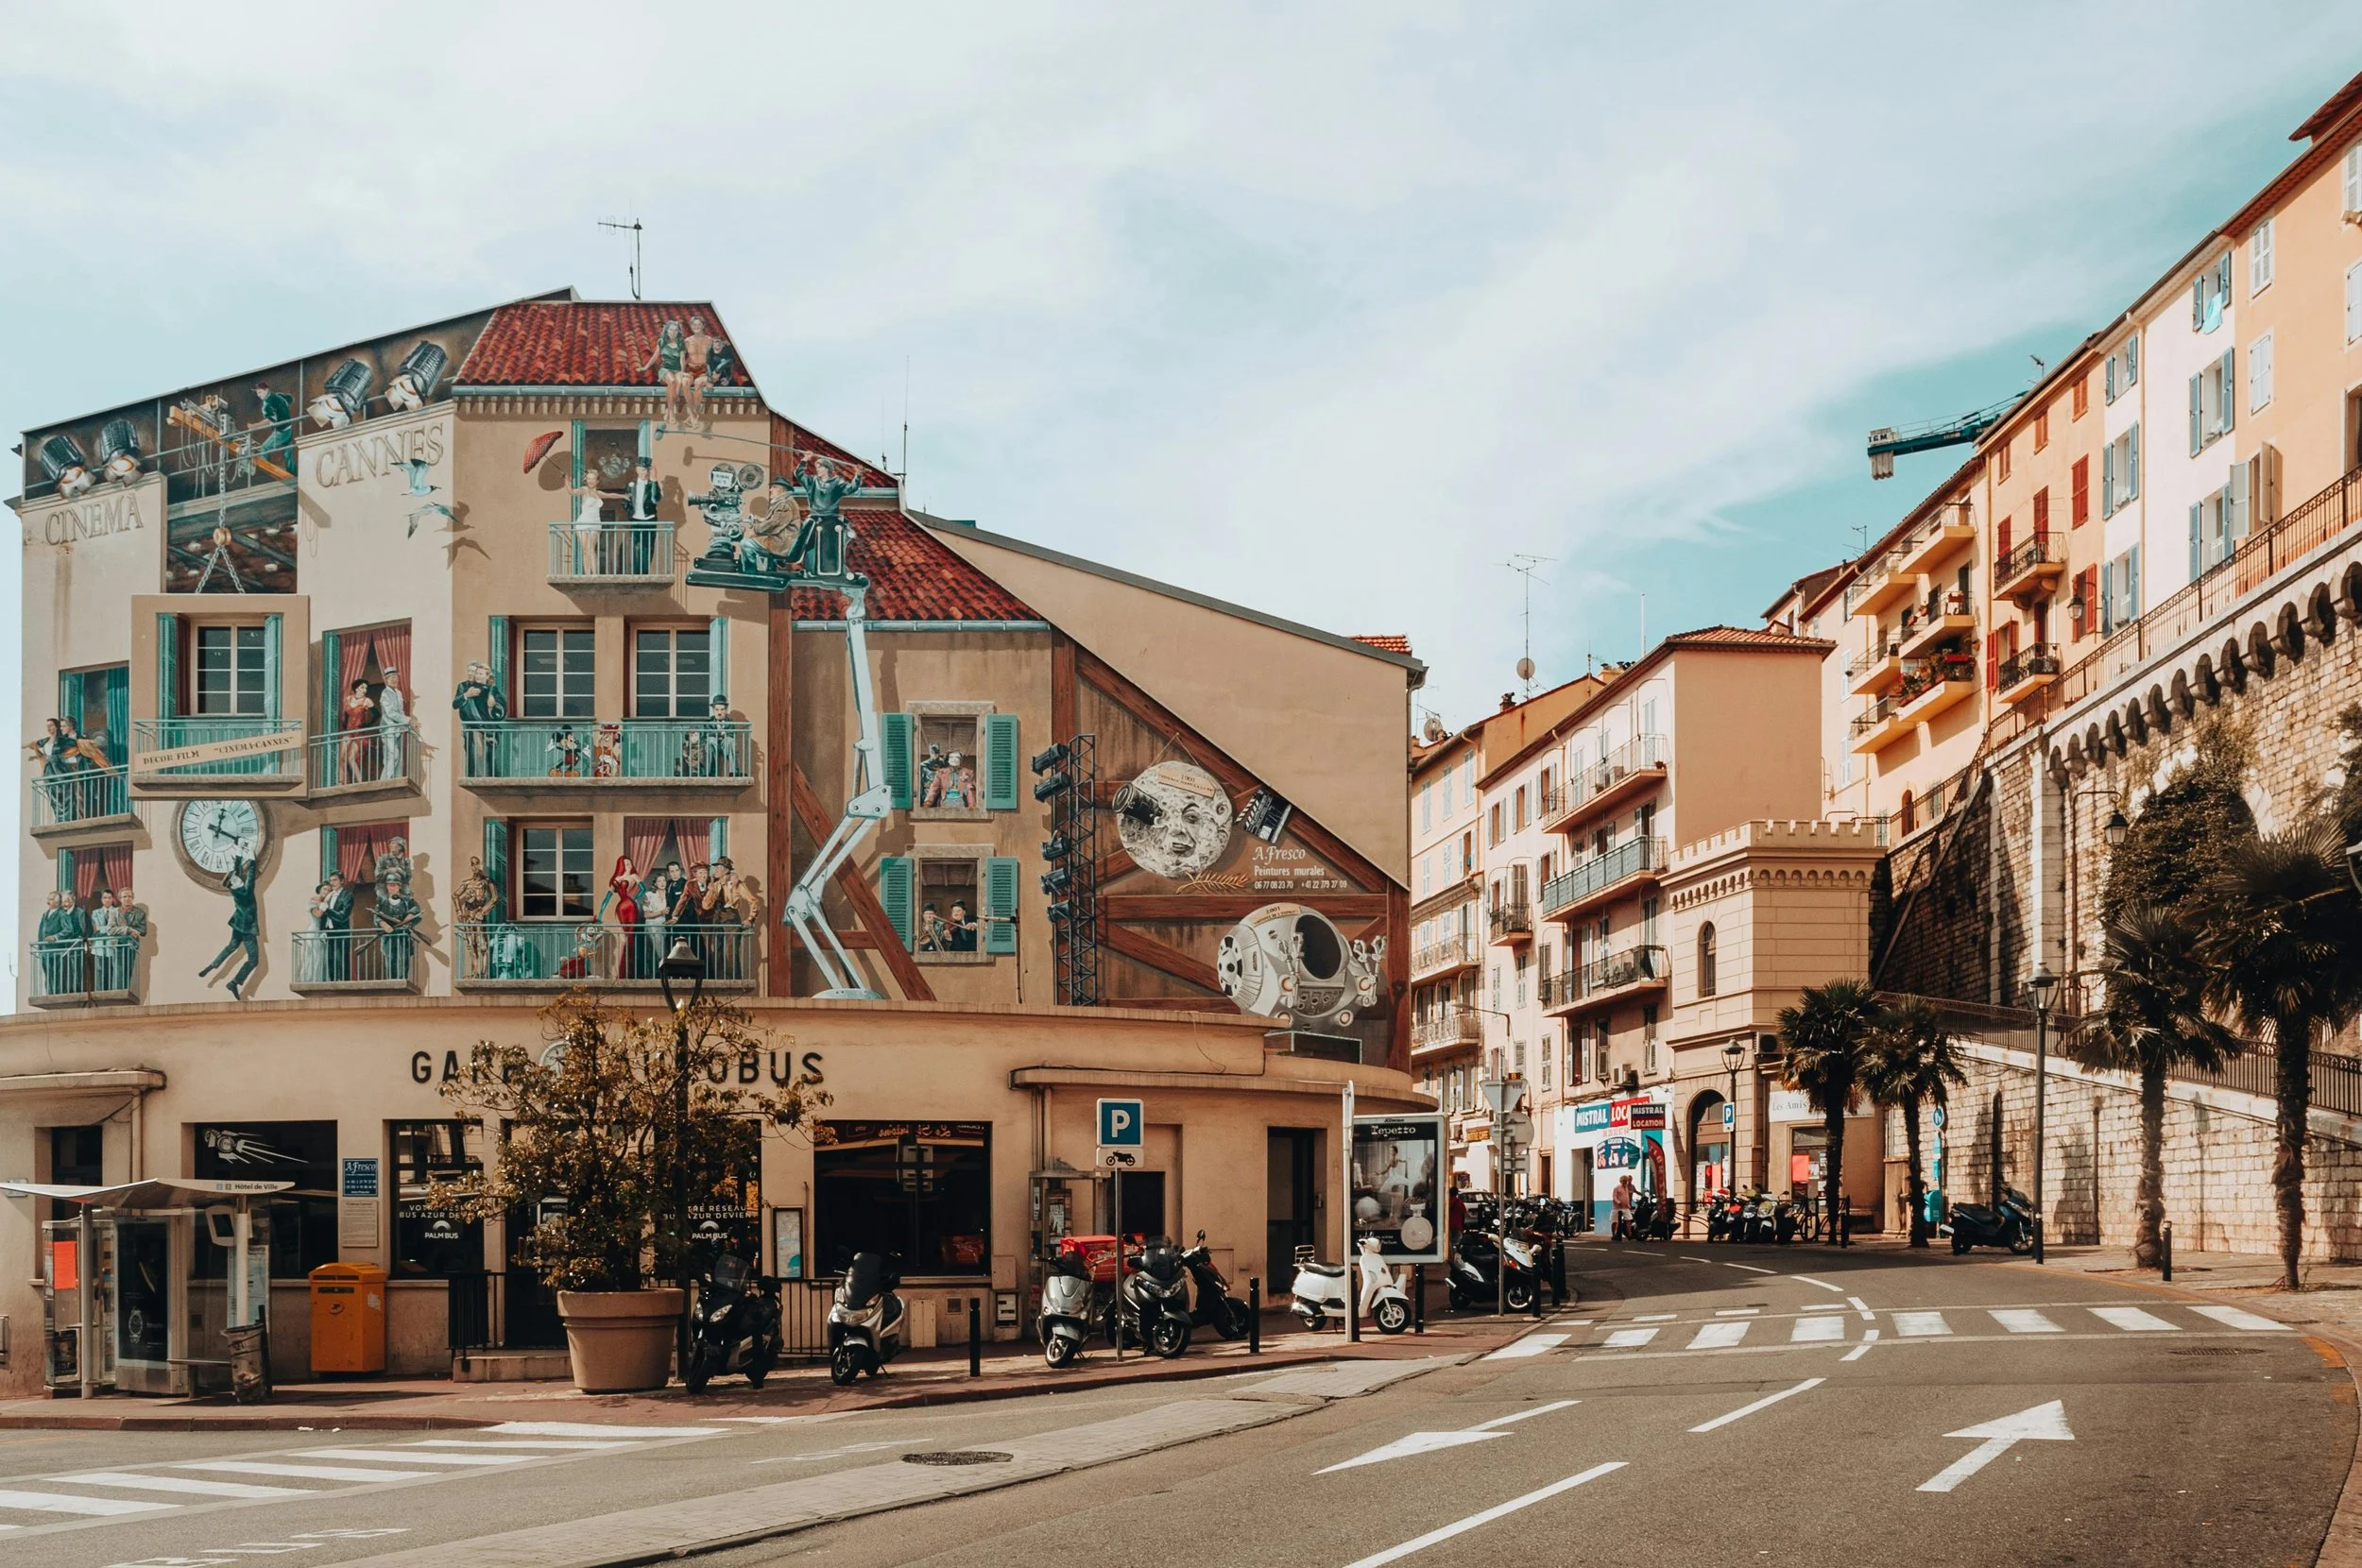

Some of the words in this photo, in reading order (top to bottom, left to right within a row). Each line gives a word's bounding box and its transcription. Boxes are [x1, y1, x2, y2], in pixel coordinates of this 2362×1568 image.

[316, 422, 444, 487] CANNES
[45, 491, 144, 545] CINEMA
[177, 750, 199, 760] FILM
[1254, 865, 1290, 876] Peintures
[1293, 865, 1325, 876] murales
[1262, 880, 1270, 889] 77
[612, 1050, 824, 1085] UOBUS
[1787, 1100, 1807, 1110] Amis
[1576, 1109, 1608, 1127] MISTRAL
[1725, 1107, 1731, 1121] P
[1111, 1109, 1130, 1138] P
[1633, 1119, 1663, 1128] LOCATION
